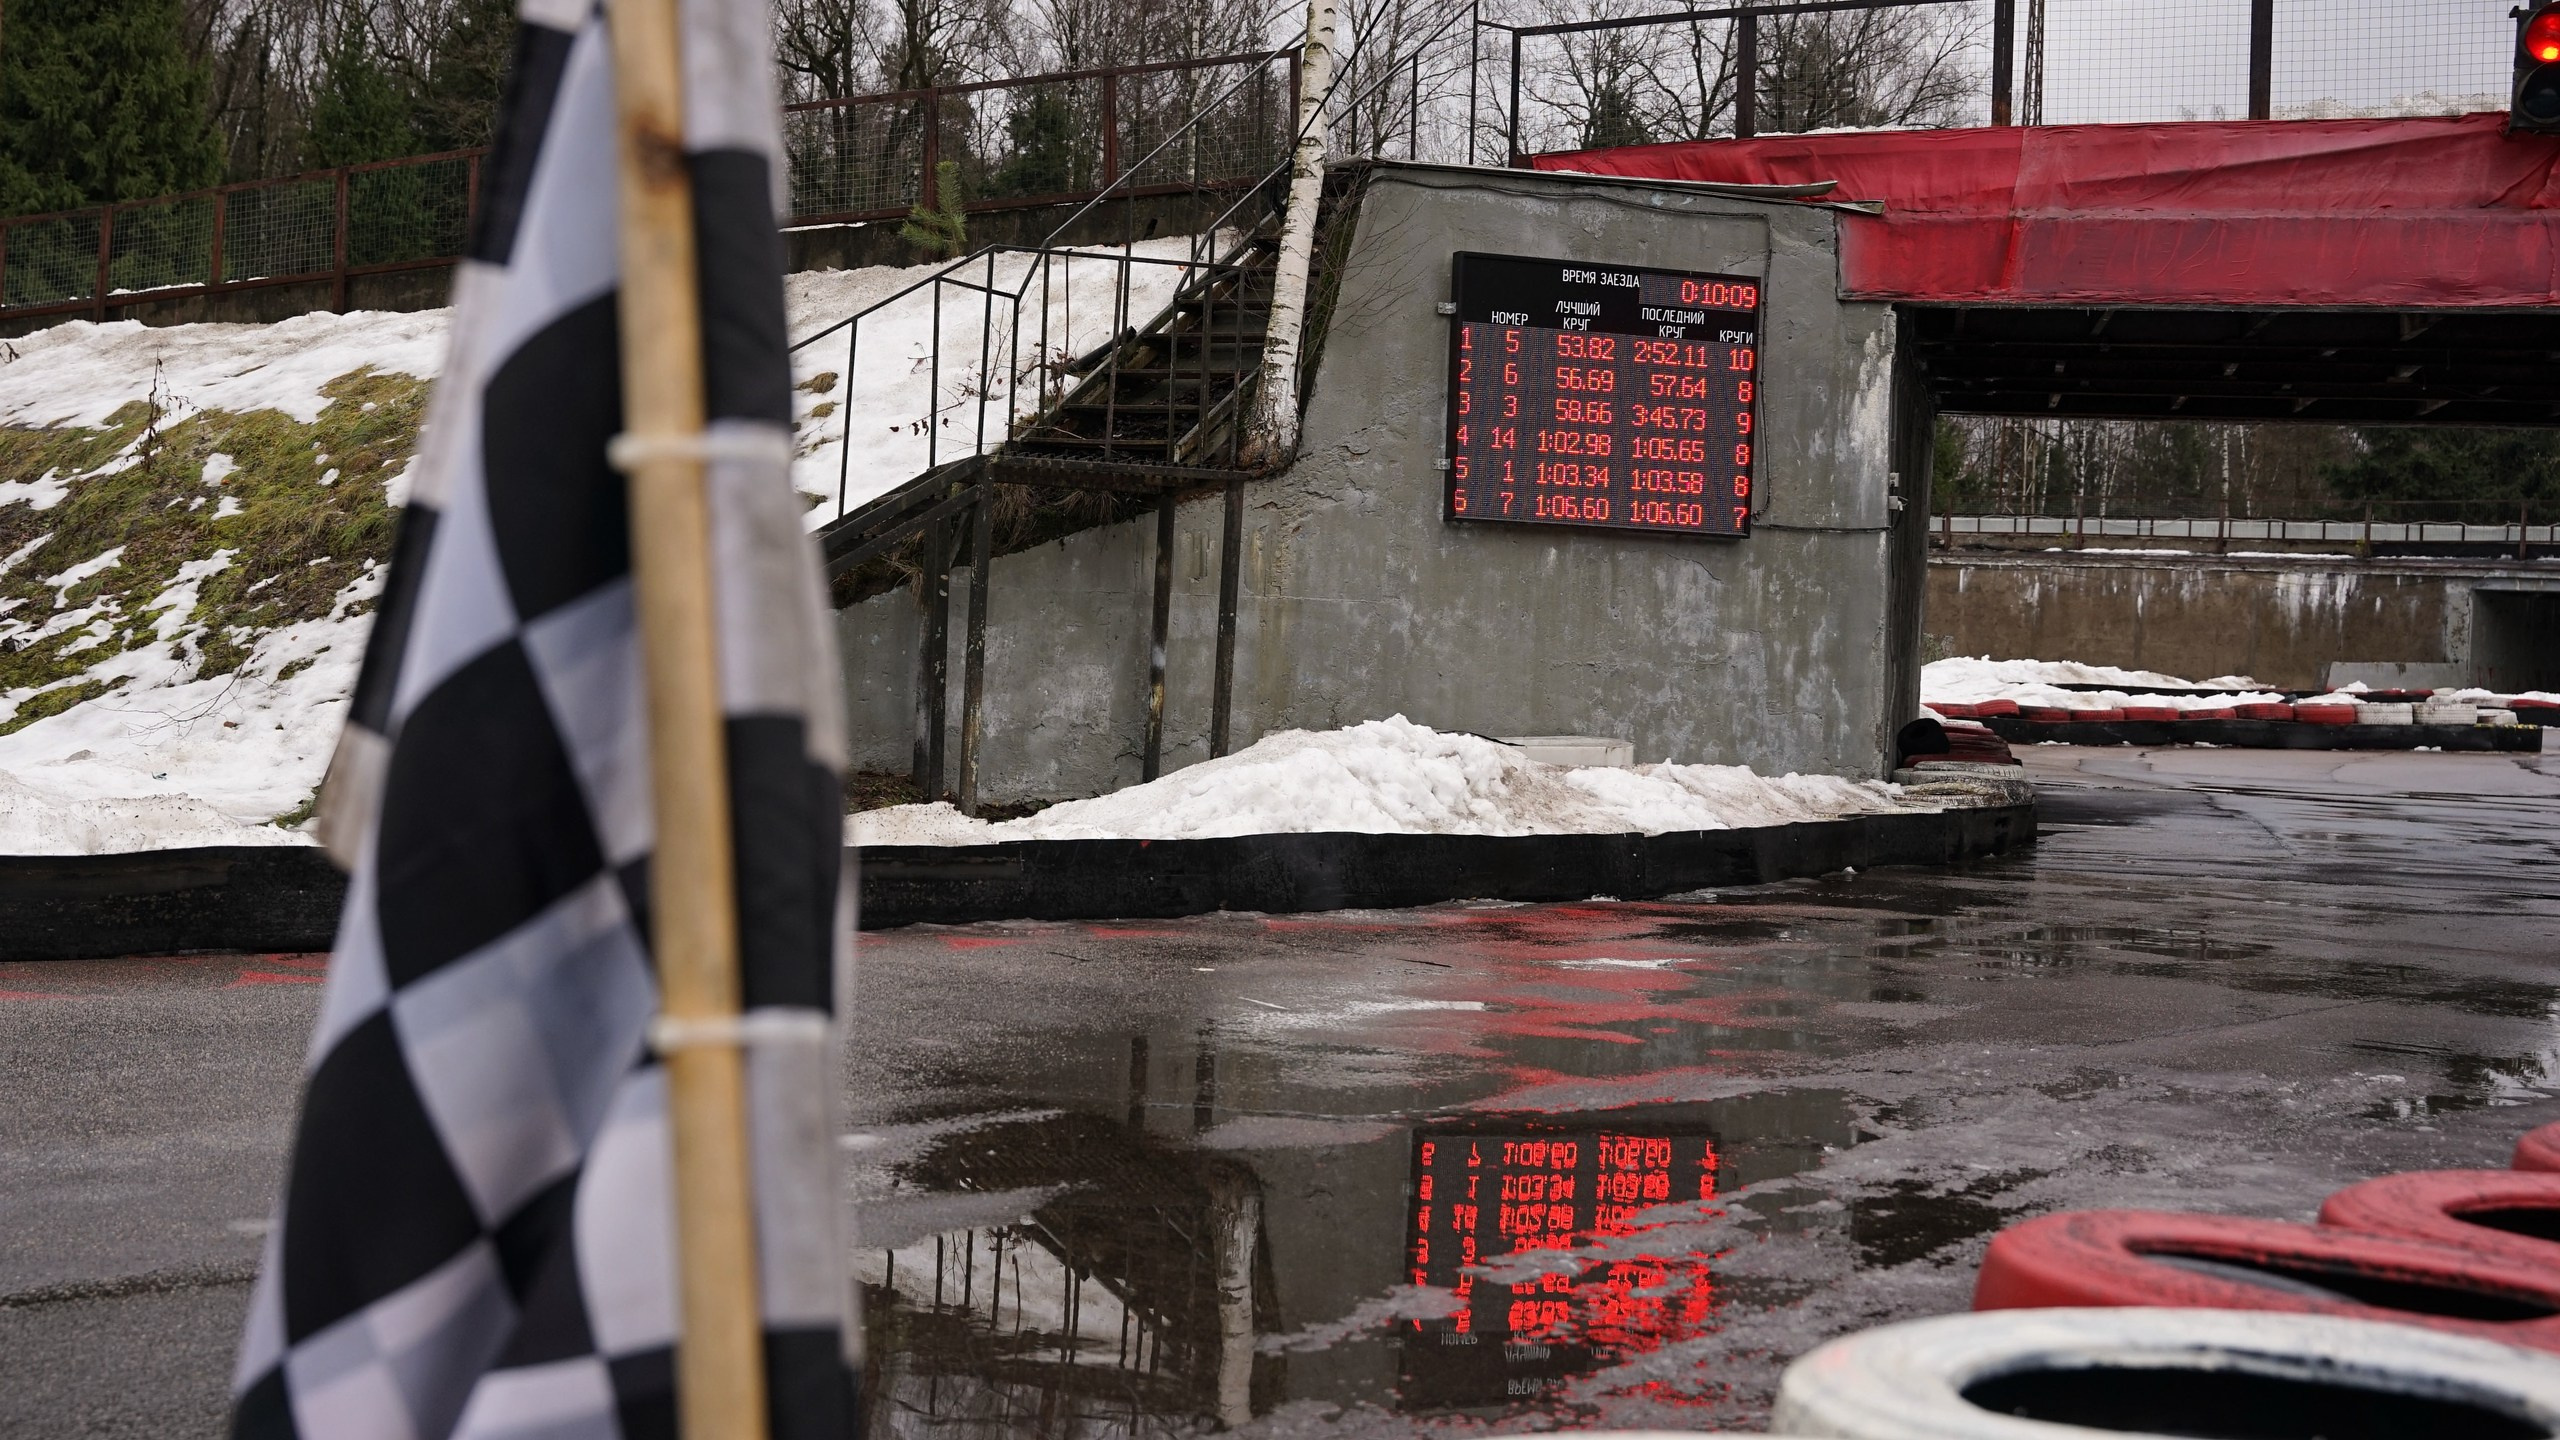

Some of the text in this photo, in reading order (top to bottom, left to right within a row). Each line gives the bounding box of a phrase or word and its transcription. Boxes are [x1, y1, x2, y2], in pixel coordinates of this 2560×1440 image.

[1562, 269, 1640, 288] ВРЕМЯ ЗАЕЗДА
[1681, 280, 1757, 308] 0:10:09
[1491, 311, 1529, 326] НОМЕР
[1555, 300, 1601, 316] ЛУЧШИЙ
[1641, 307, 1705, 325] ПОСЛЕДНИЙ
[1563, 317, 1591, 331] КРУГ
[1658, 325, 1687, 339] КРУГ
[1461, 327, 1754, 371] 1 5 53.82 2:52.11 10
[1719, 330, 1753, 345] КРУГИ
[1460, 359, 1752, 402] 2 6 56.69 57.64 8
[1458, 391, 1751, 434] 3 3 58.66 3:45.73 9
[1457, 424, 1750, 465] 4 14 1:02.98 1:05.65 8
[1455, 456, 1749, 497] 5 1 1:03.34 1:03.58 8
[1454, 489, 1748, 529] 6 7 1:06.60 1:06.60 7
